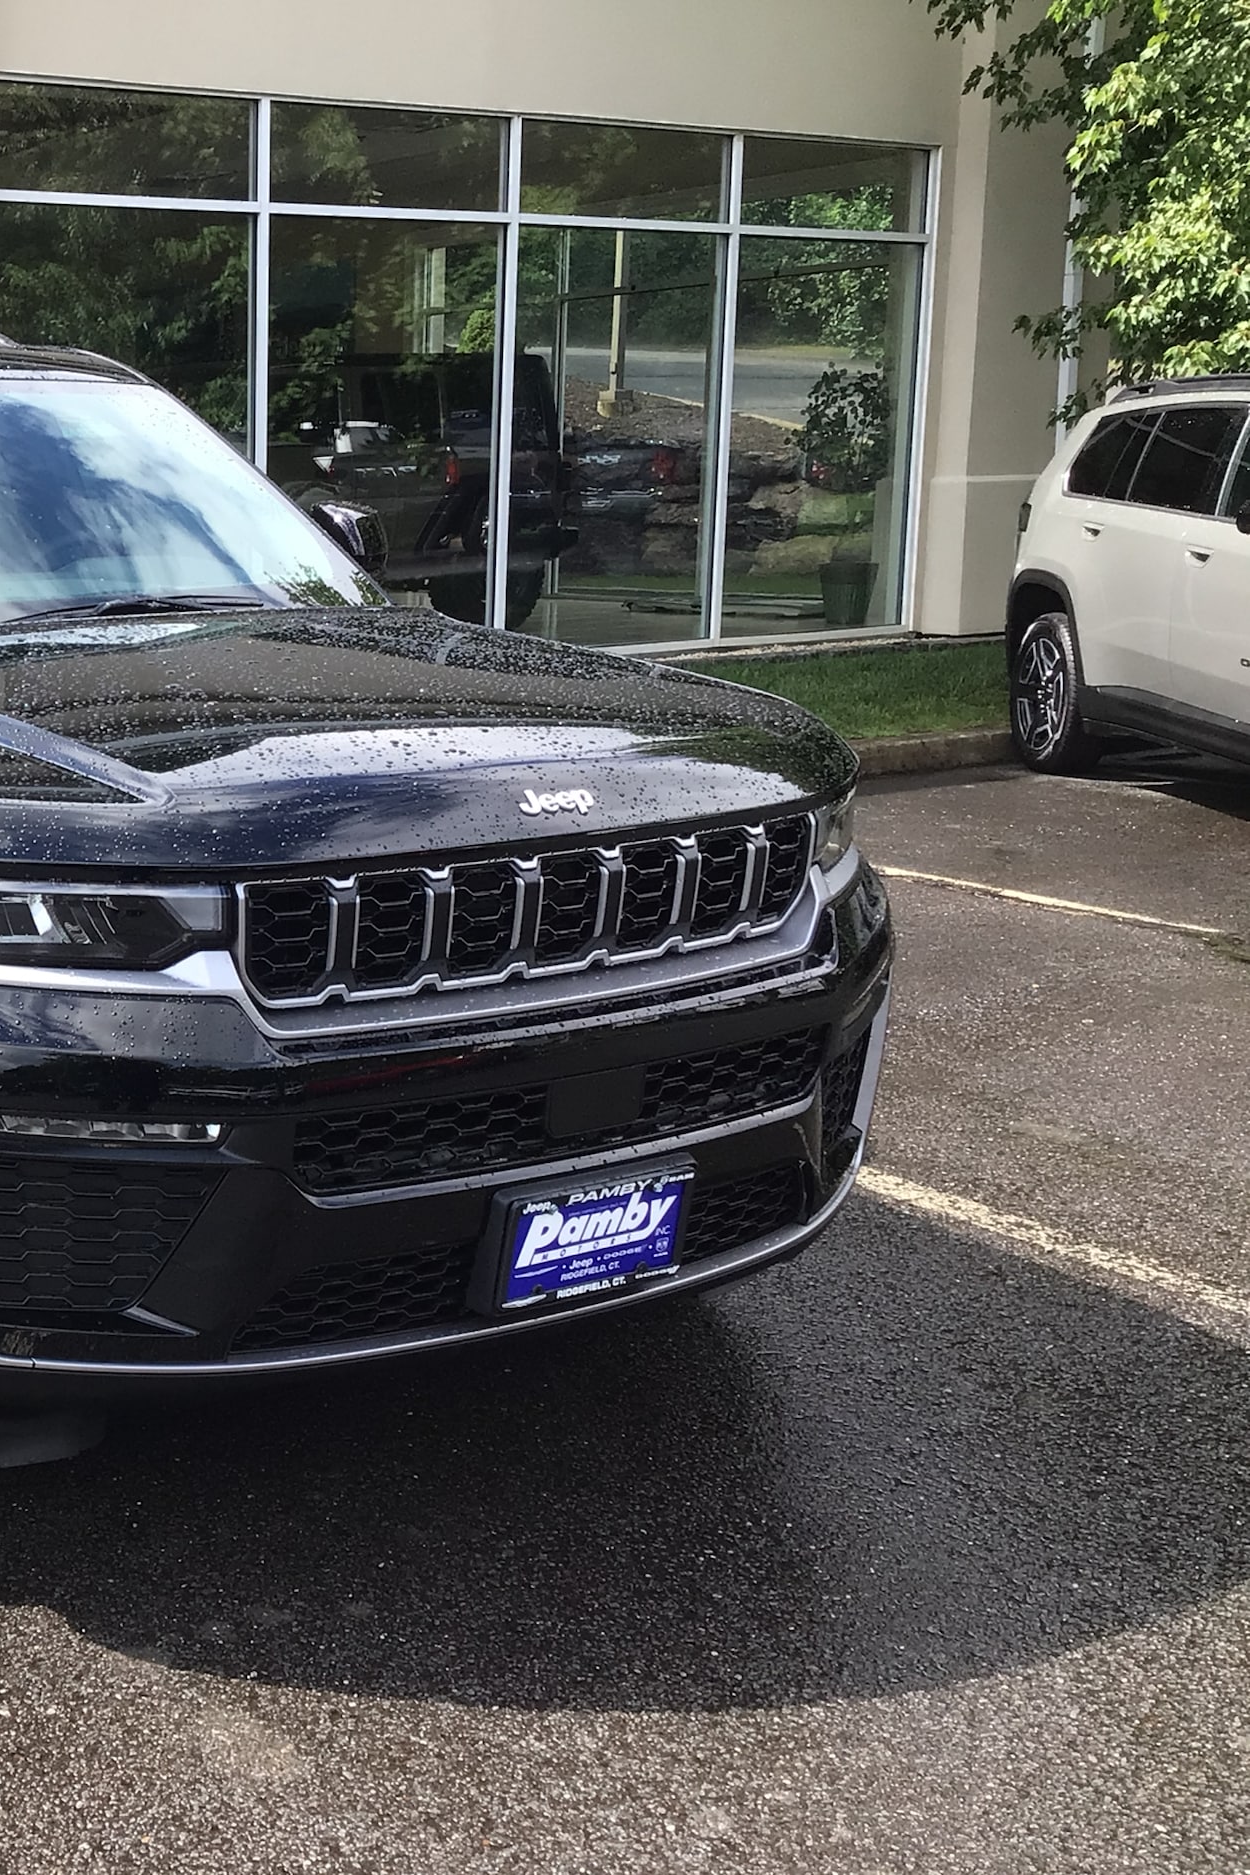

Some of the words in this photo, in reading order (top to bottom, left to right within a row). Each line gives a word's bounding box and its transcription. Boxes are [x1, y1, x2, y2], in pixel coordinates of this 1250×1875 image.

[519, 789, 594, 815] Jeep
[565, 1179, 652, 1207] PAMBY
[522, 1201, 551, 1215] Jeep
[514, 1191, 678, 1269] Pamby
[541, 1233, 632, 1260] MOTORS
[569, 1258, 593, 1270] Jeep
